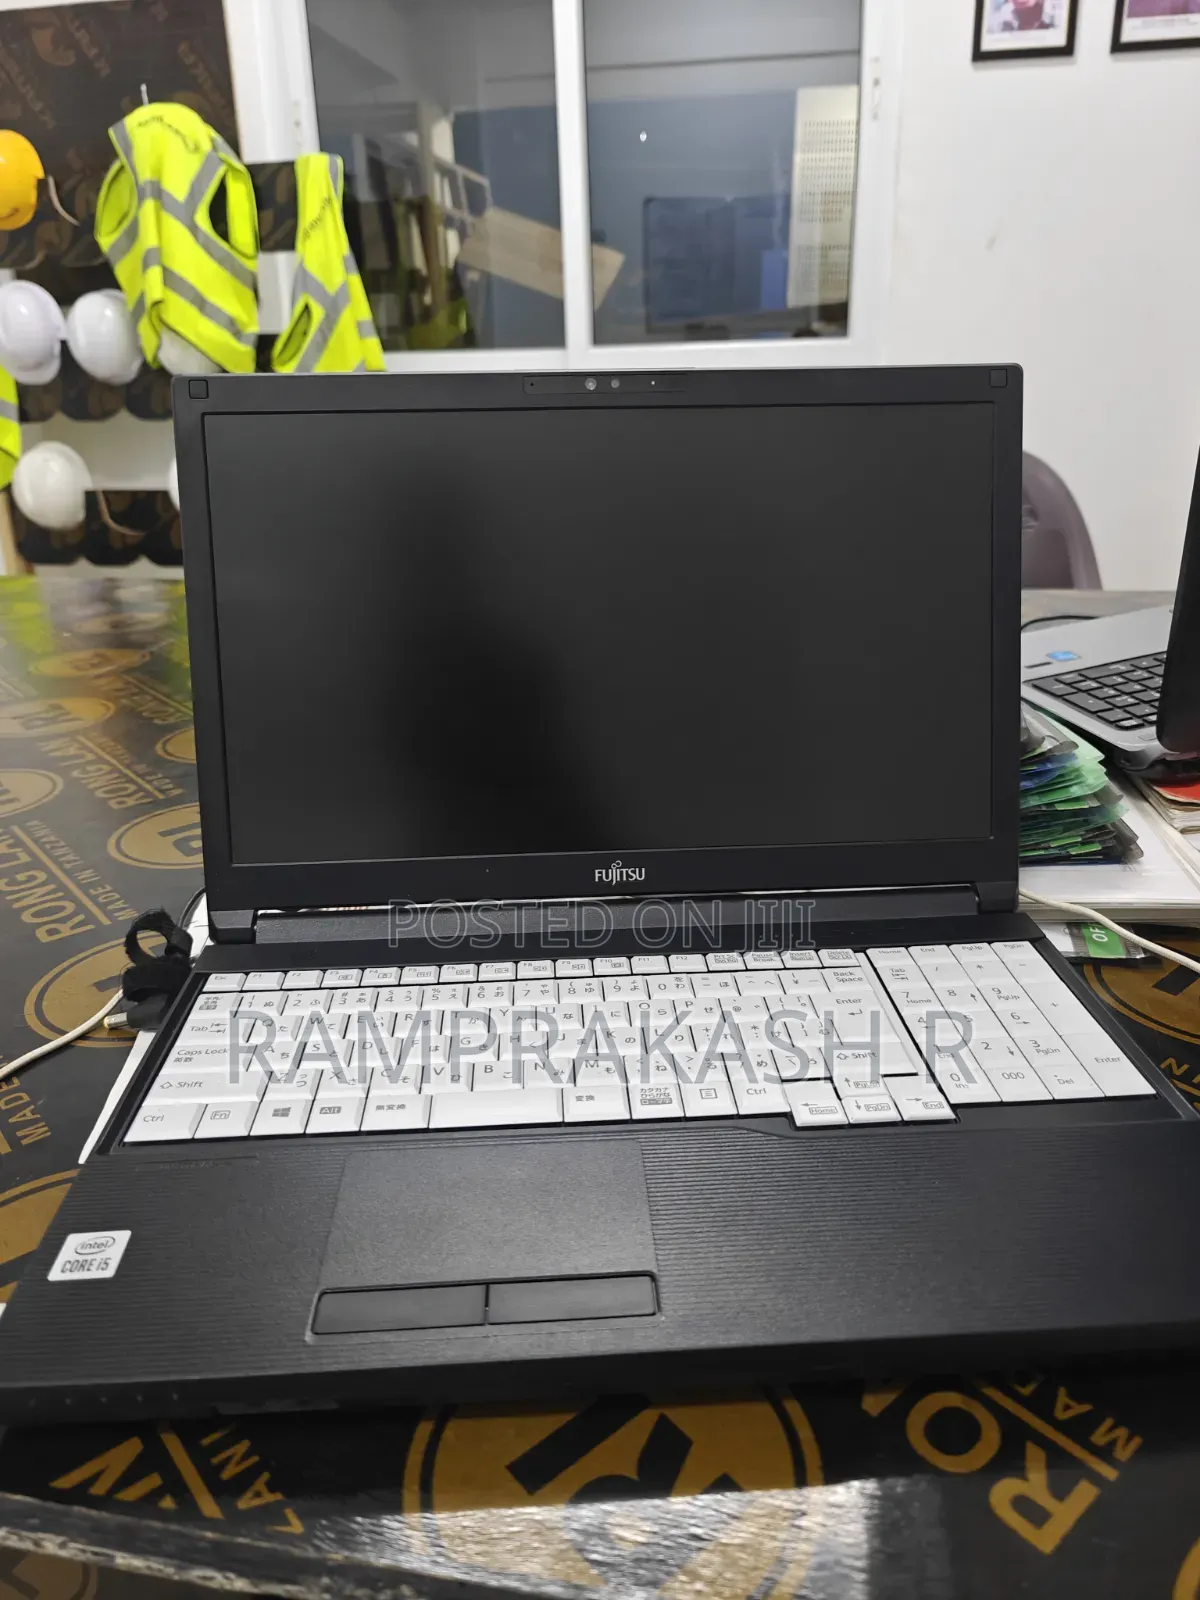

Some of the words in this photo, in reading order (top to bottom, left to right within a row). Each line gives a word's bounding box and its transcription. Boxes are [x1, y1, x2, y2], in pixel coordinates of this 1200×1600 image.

[73, 868, 100, 884] IN
[594, 860, 646, 886] FUJITSU
[90, 884, 138, 920] MADE
[522, 989, 531, 997] 7
[568, 987, 576, 995] 8
[902, 991, 910, 999] 7
[947, 989, 957, 997] 8
[992, 987, 1002, 995] 9
[997, 994, 1021, 1002] PgUp
[638, 1002, 650, 1010] O
[685, 1000, 694, 1008] P
[499, 1008, 509, 1017] Y
[545, 1006, 555, 1014] U
[357, 1015, 366, 1023] E
[404, 1013, 414, 1021] R
[1011, 1012, 1021, 1020] 6
[262, 1018, 274, 1028] Q
[310, 1017, 323, 1025] W
[558, 1033, 566, 1041] J
[606, 1030, 616, 1039] K
[655, 1028, 665, 1037] L
[460, 1036, 471, 1045] G
[1029, 1039, 1041, 1048] 3
[264, 1045, 275, 1053] A
[312, 1043, 321, 1051] S
[362, 1041, 373, 1050] D
[981, 1041, 993, 1051] 2
[851, 1052, 877, 1060] Shift
[1036, 1048, 1061, 1056] PgDn
[585, 1059, 600, 1068] M
[1094, 1056, 1121, 1064] Enter
[433, 1066, 445, 1076] V
[484, 1064, 494, 1074] B
[534, 1062, 546, 1071] N
[329, 1070, 342, 1080] X
[380, 1068, 393, 1078] C
[949, 1072, 961, 1082] 0
[1001, 1071, 1025, 1080] 000
[1056, 1077, 1075, 1085] Del
[746, 1087, 767, 1096] Ctrl
[320, 1106, 341, 1114] Alt
[866, 1103, 890, 1112] PgDn
[924, 1101, 943, 1110] End
[0, 1077, 51, 1146] MADE
[212, 1111, 229, 1119] Fn
[143, 1115, 165, 1123] Ctrl
[79, 1239, 110, 1251] intel
[60, 1258, 97, 1274] CORE
[95, 1256, 112, 1272] i5
